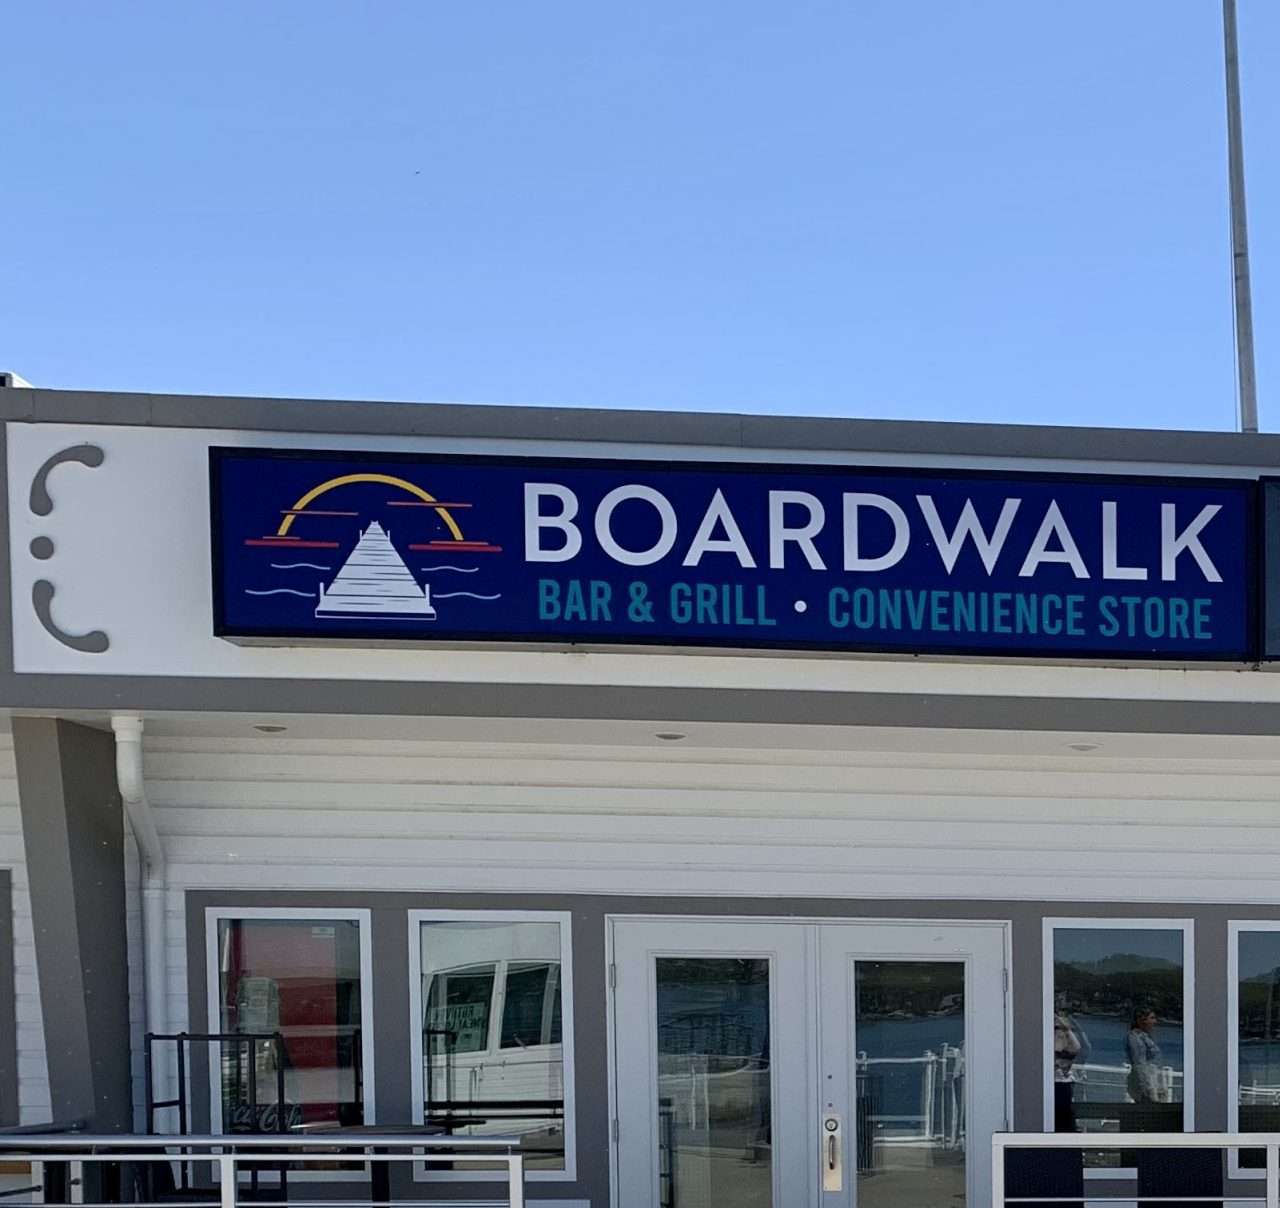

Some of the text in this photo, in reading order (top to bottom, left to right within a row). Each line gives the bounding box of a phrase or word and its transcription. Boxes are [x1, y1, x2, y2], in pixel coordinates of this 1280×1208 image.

[524, 482, 1223, 583] BOARDWALK
[538, 579, 1213, 640] BAR & GRILL CONVENIENCE STORE
